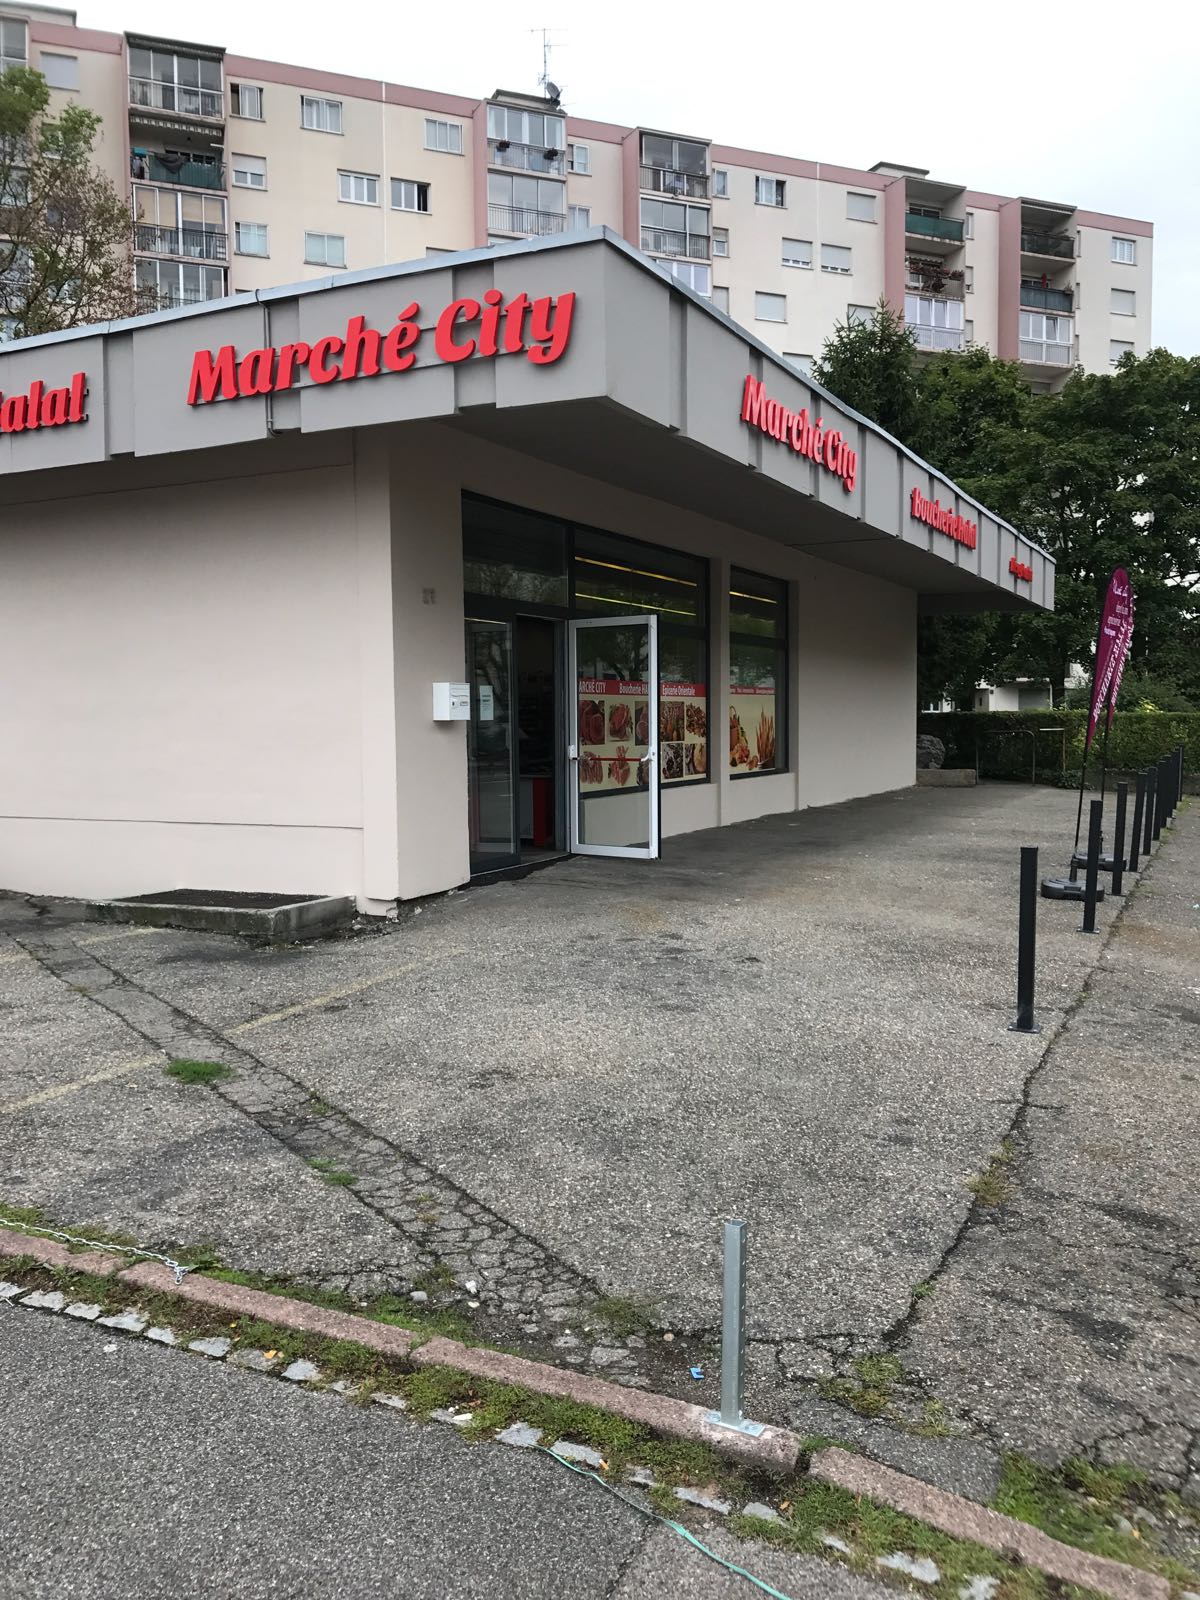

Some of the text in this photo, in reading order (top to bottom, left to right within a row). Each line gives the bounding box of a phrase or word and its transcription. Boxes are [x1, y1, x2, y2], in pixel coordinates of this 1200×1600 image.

[187, 289, 577, 406] Marché City
[0, 372, 88, 434] alal
[741, 374, 857, 493] Marché City
[579, 680, 607, 693] ARCHÉ CITY
[619, 684, 641, 695] Boucherie
